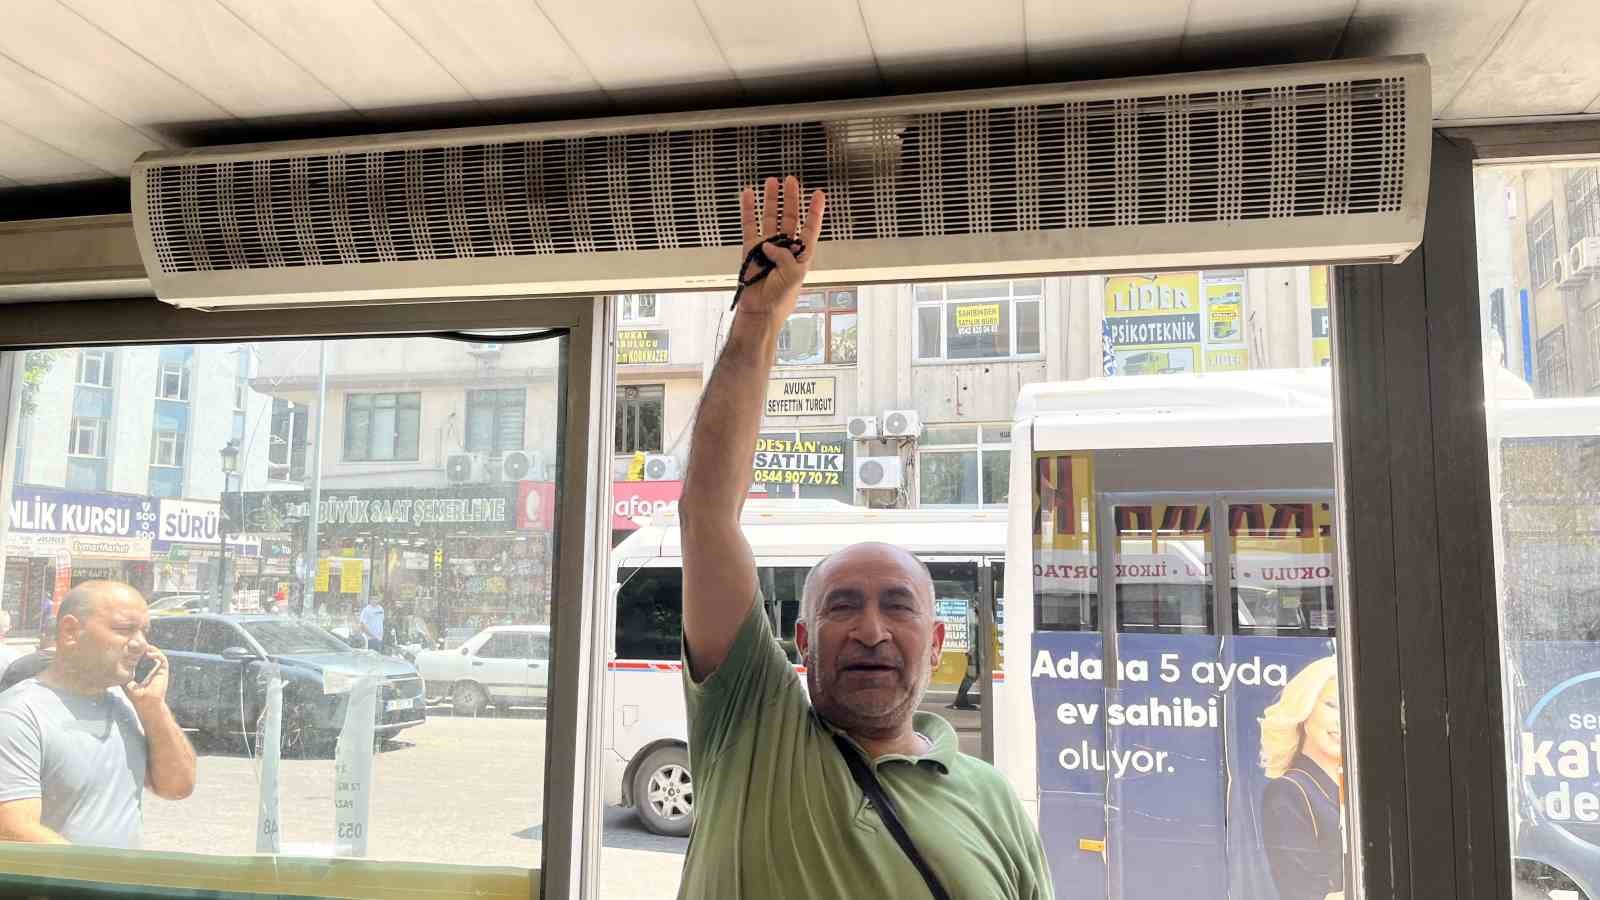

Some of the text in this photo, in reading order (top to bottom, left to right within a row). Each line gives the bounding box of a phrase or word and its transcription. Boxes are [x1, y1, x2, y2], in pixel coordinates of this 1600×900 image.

[1113, 282, 1189, 312] LİDER
[1111, 317, 1195, 343] PSİKOTEKNİK
[783, 382, 816, 395] AVUKAT
[805, 398, 832, 411] TURGUT
[755, 453, 839, 470] SATILIK
[754, 470, 839, 485] 0544 907 70 72
[61, 503, 130, 536] KURSU
[165, 508, 222, 539] SÜRÜ
[318, 496, 370, 524] BÜYÜK
[370, 500, 412, 523] SAAT
[1159, 653, 1181, 683] 5
[1191, 656, 1288, 692] ayda
[1056, 696, 1219, 728] ev sahibi
[1058, 740, 1176, 780] oluyor.
